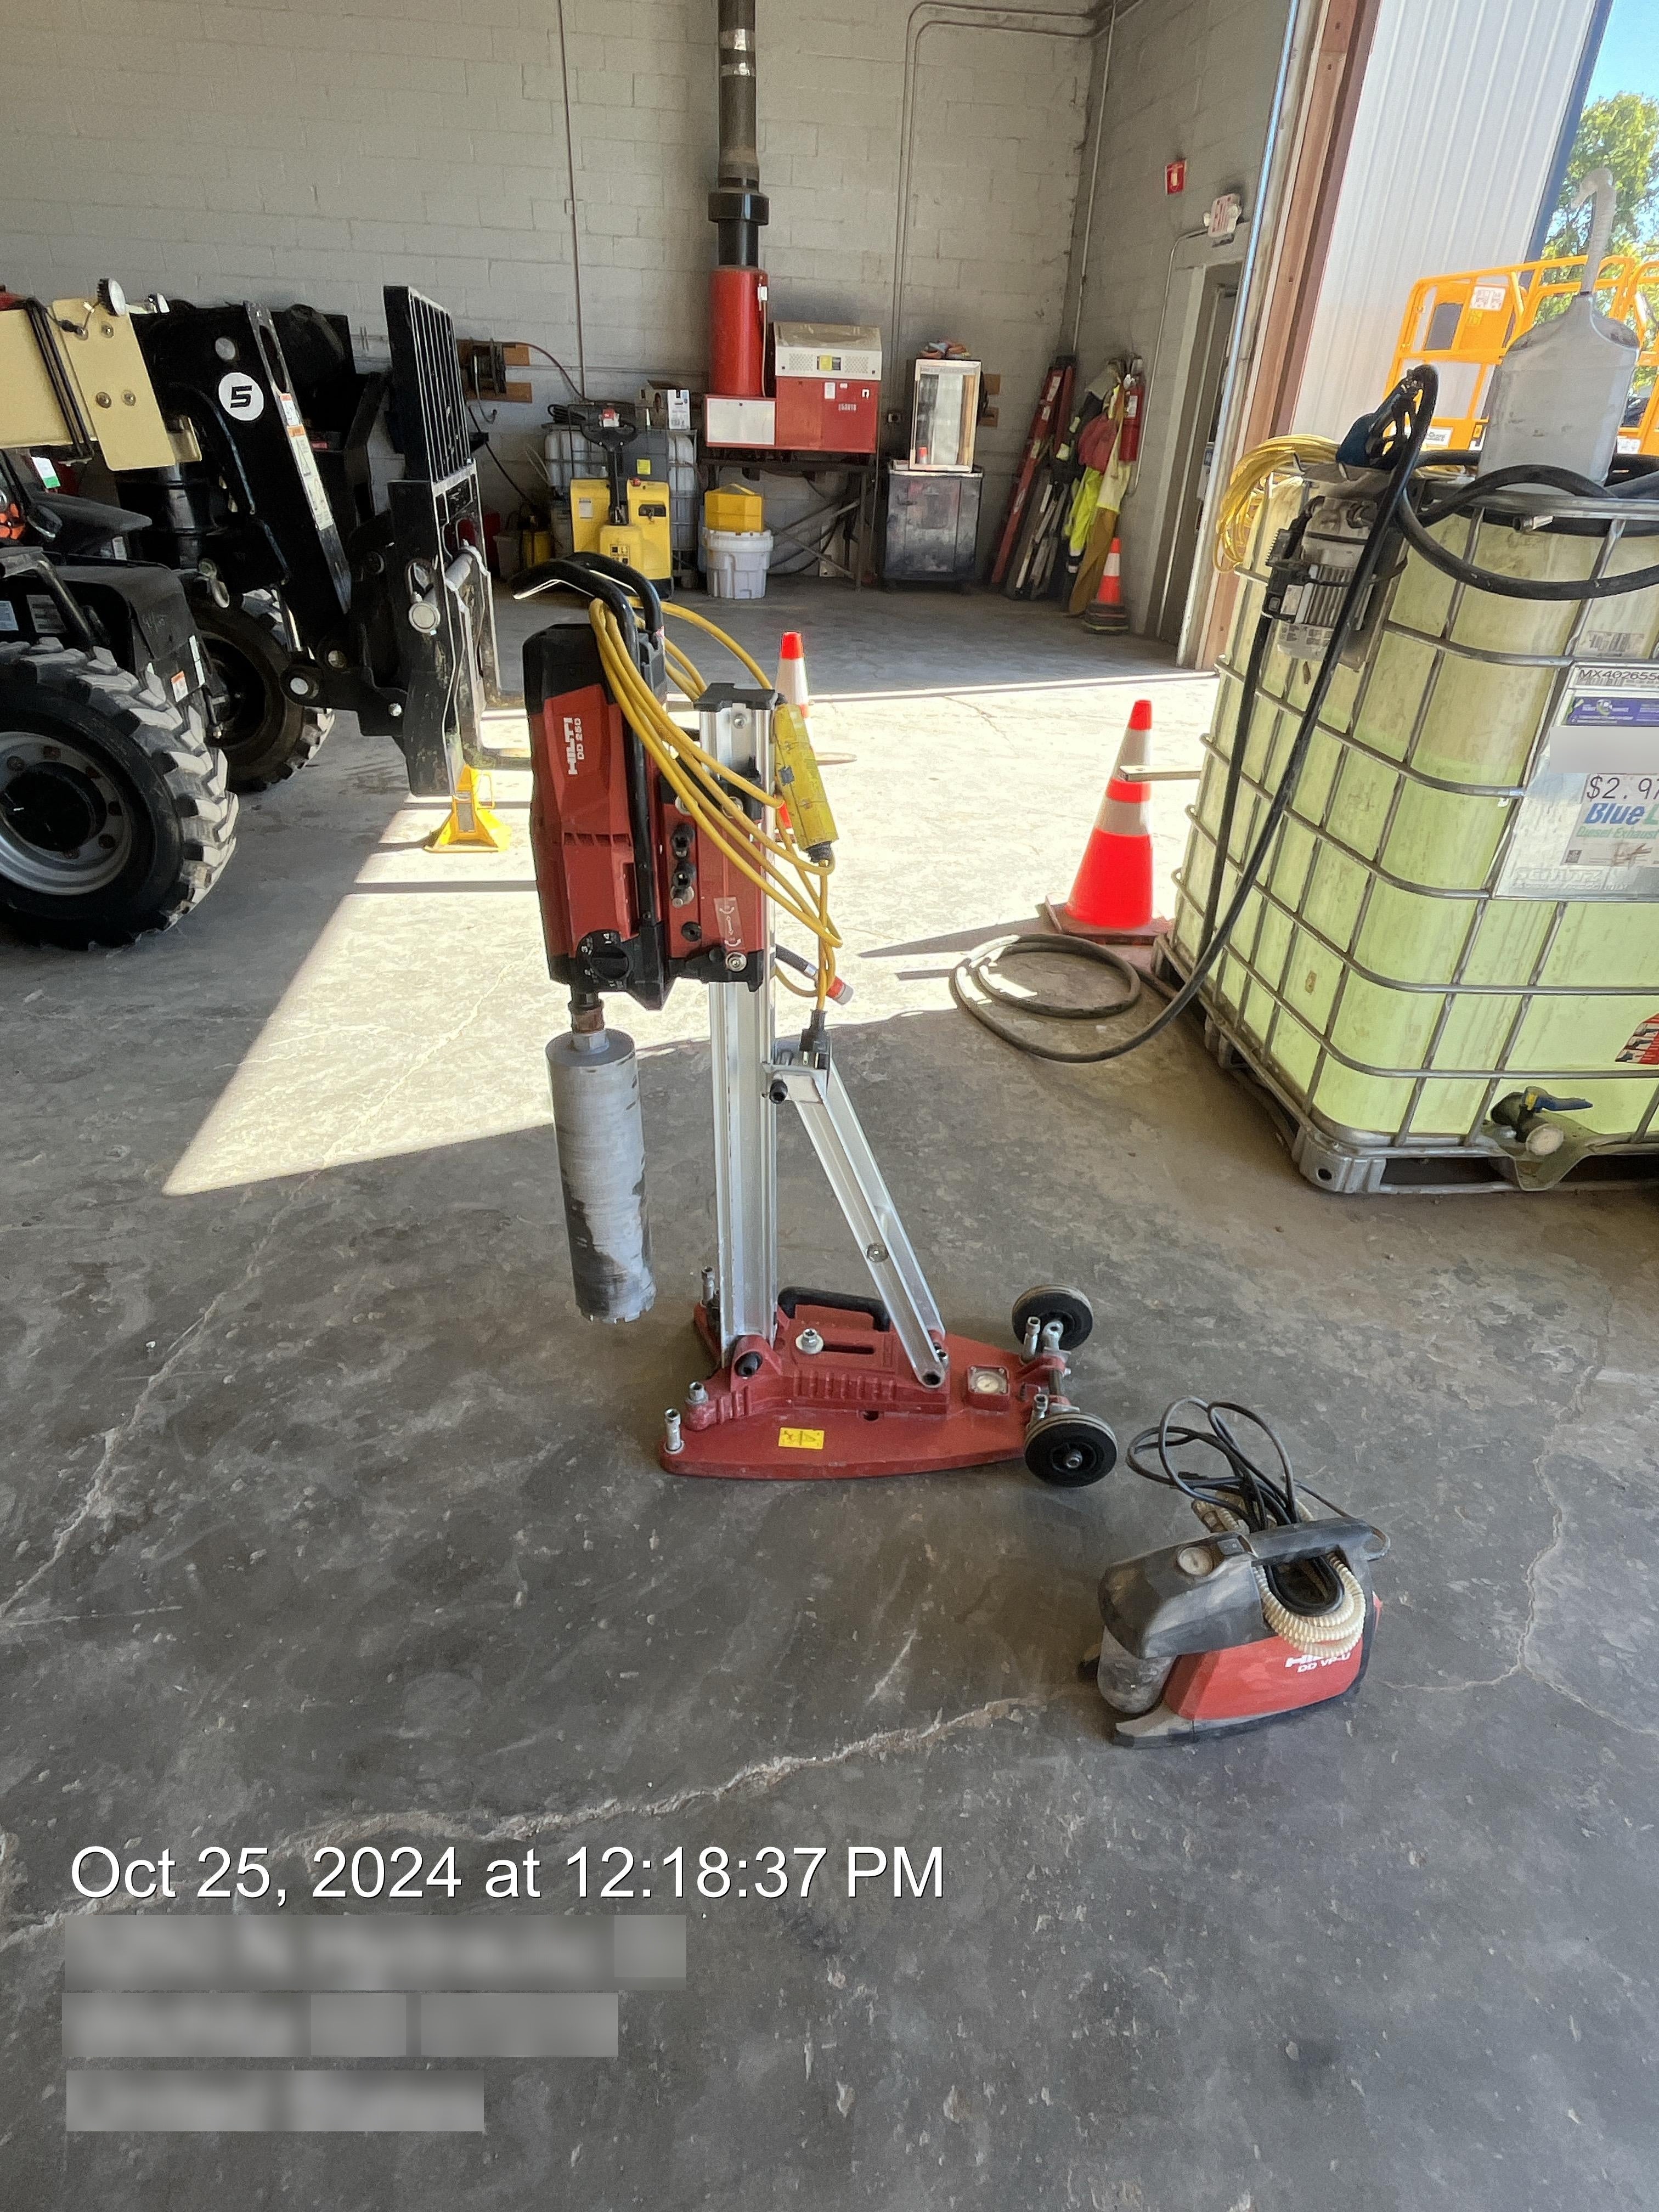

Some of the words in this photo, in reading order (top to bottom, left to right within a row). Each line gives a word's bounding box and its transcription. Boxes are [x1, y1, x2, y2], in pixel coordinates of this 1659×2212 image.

[574, 717, 583, 741] 250
[563, 717, 578, 775] HILTI
[577, 743, 584, 760] DD
[1297, 1663, 1318, 1673] DD
